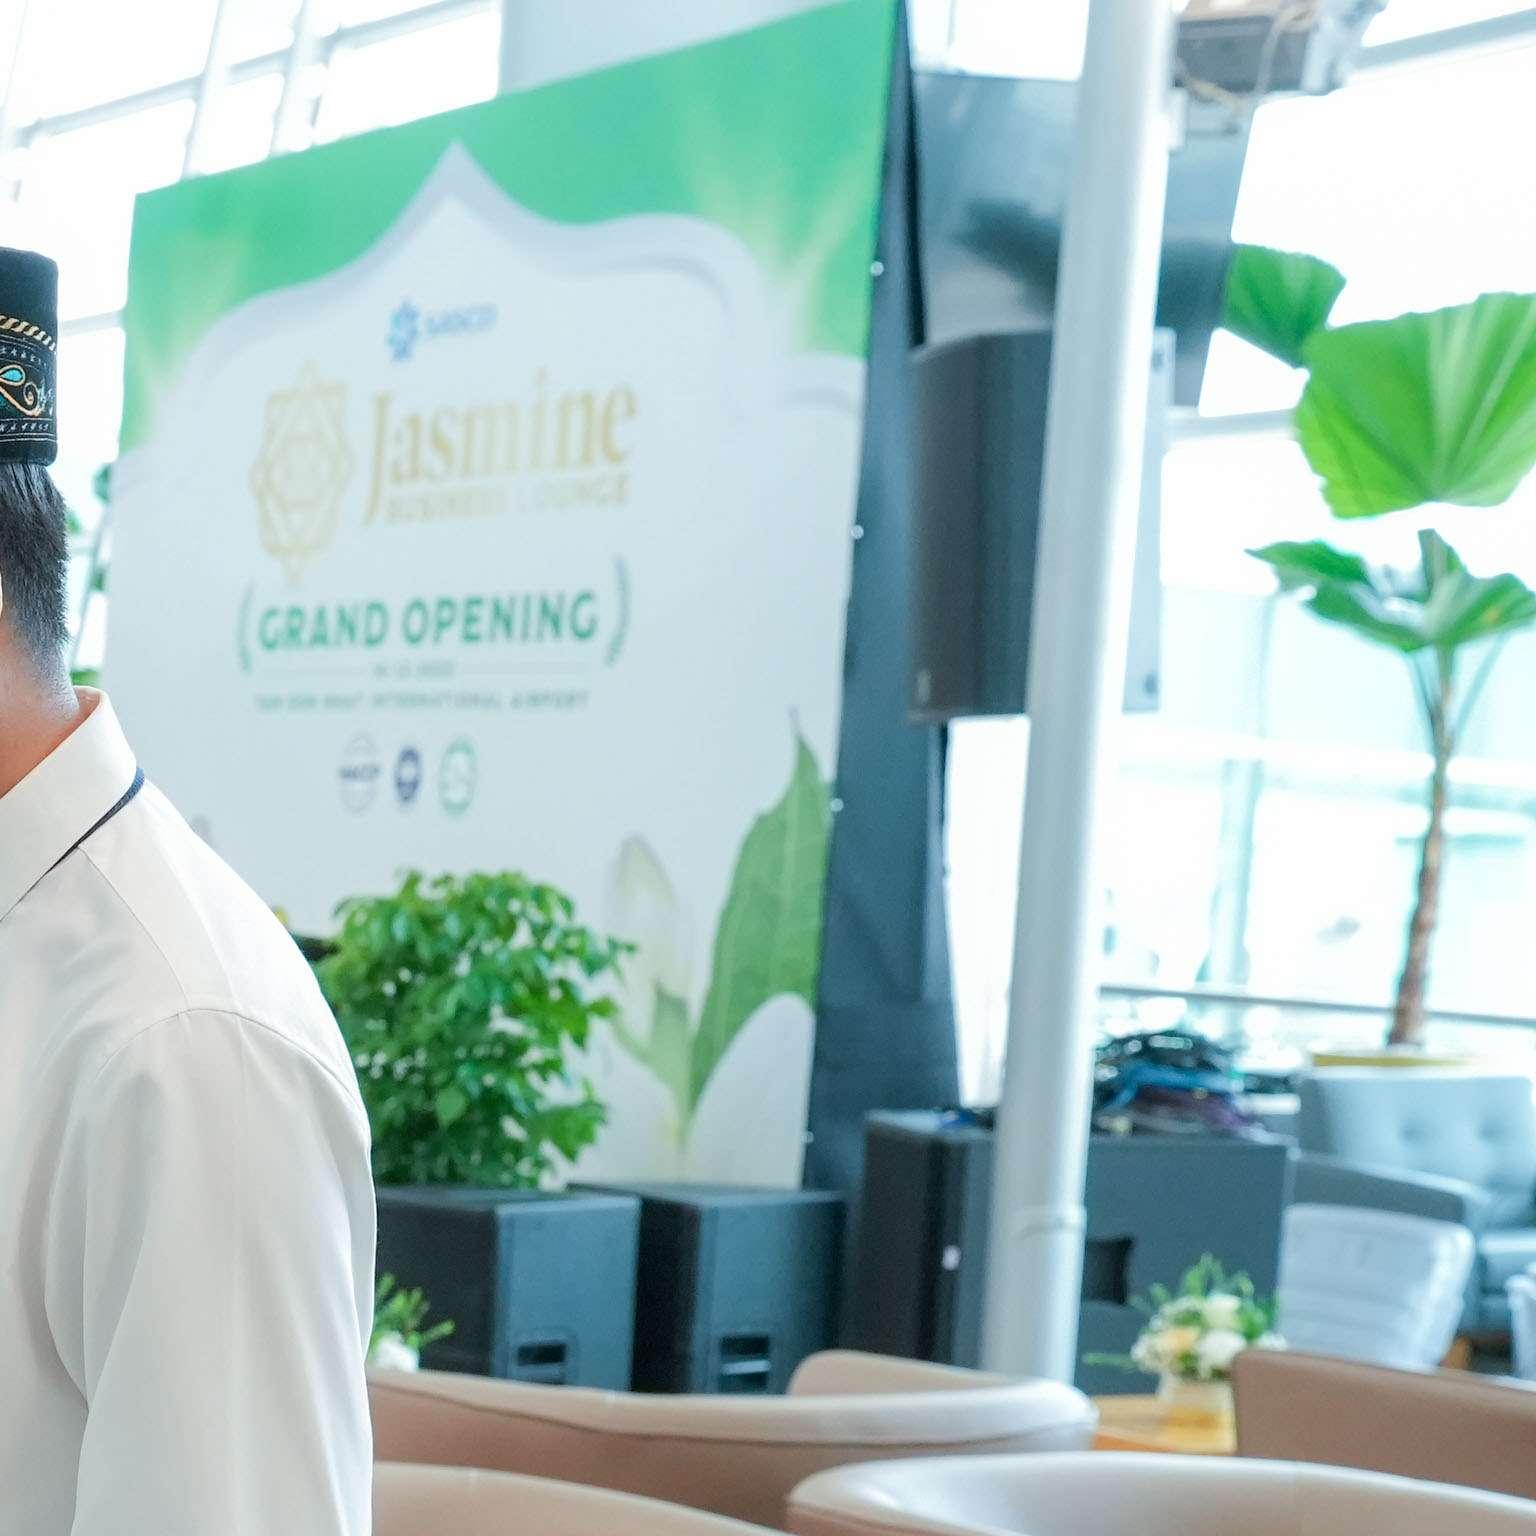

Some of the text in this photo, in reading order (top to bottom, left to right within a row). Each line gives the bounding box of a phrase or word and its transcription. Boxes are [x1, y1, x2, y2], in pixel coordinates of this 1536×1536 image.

[361, 367, 636, 526] Jasmine
[258, 590, 599, 651] GRAND OPENING
